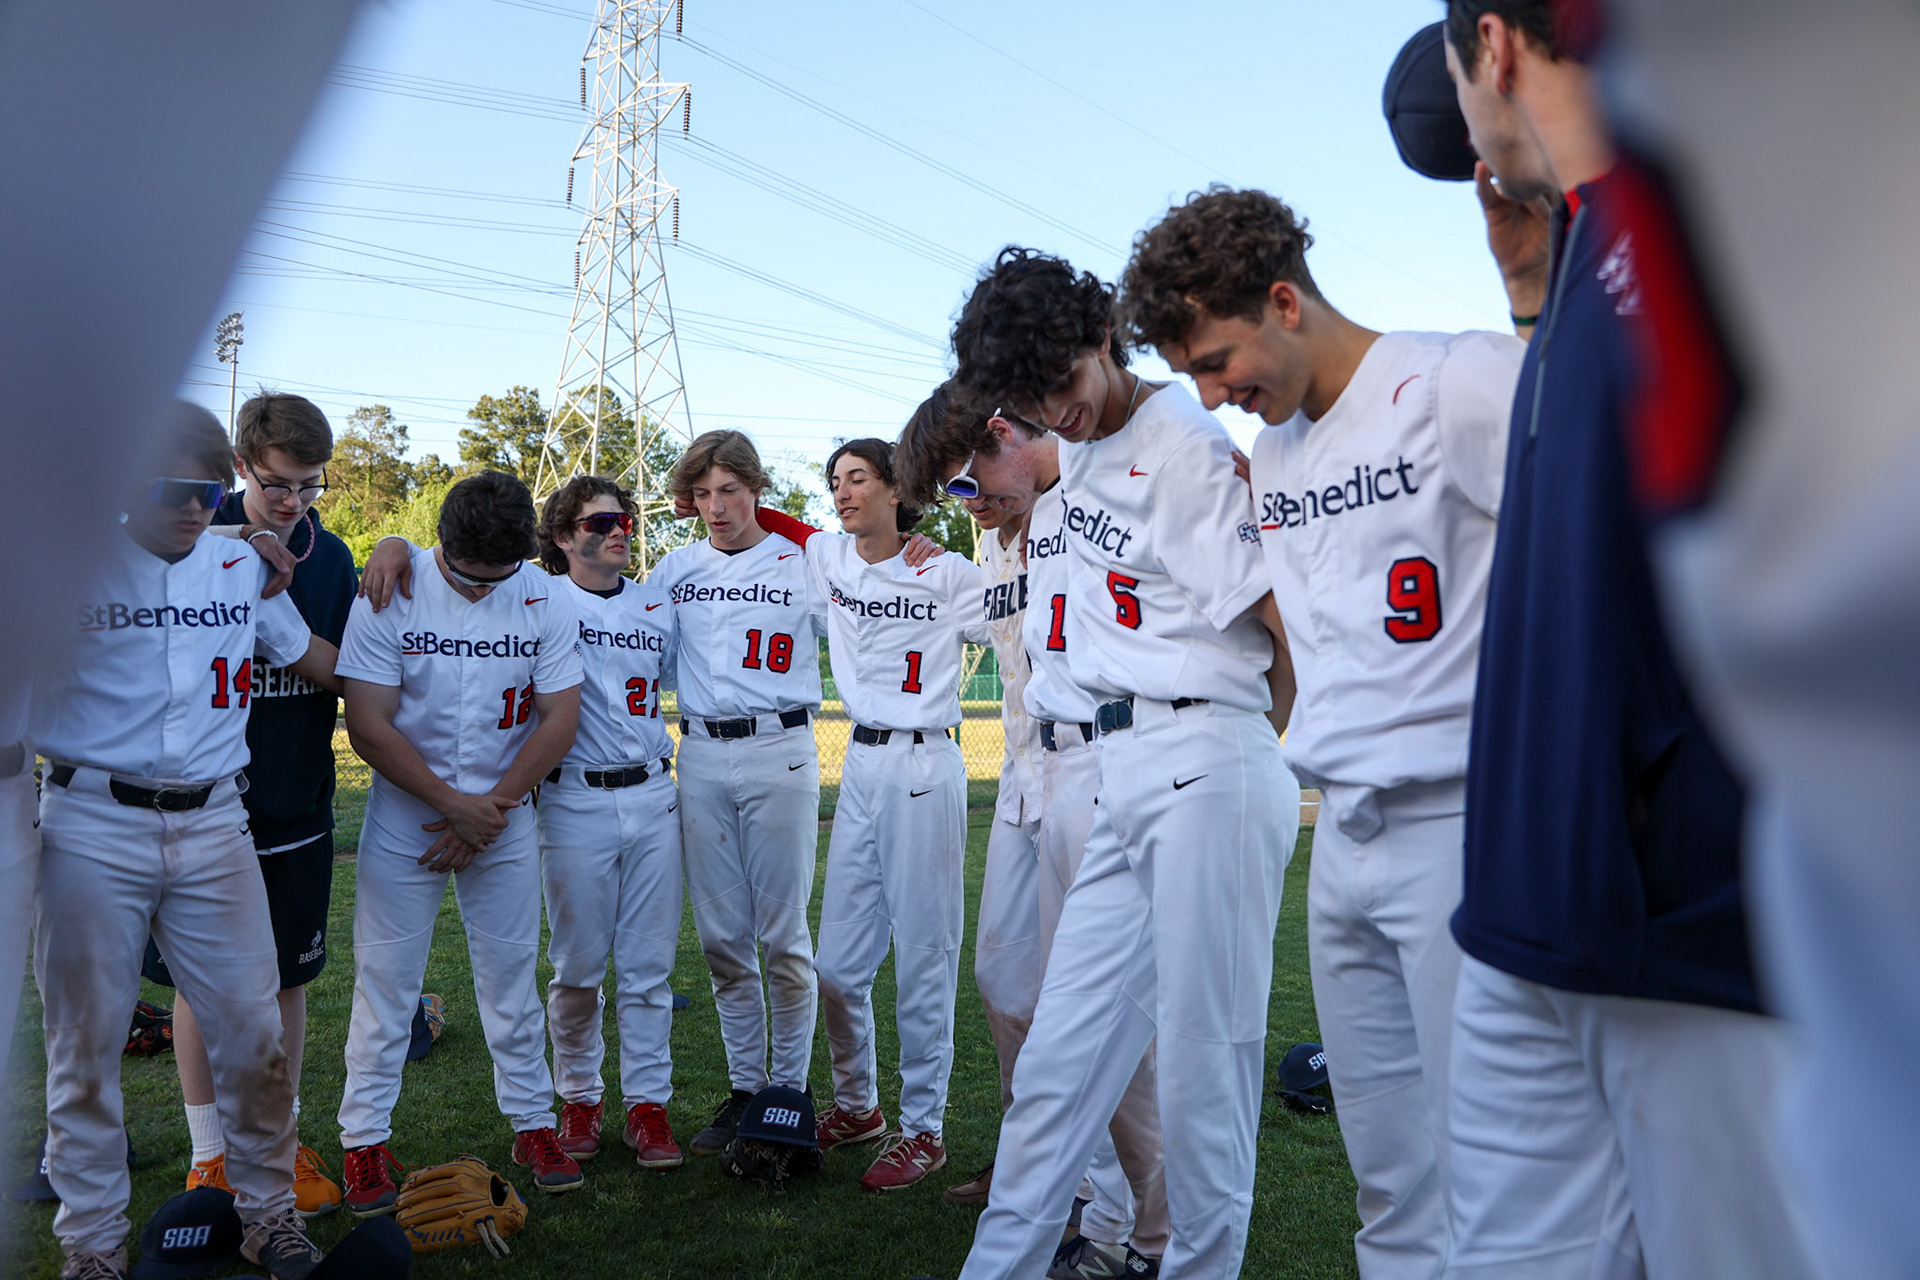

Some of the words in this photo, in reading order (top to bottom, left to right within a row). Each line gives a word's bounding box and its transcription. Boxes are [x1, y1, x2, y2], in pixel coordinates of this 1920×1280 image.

[1046, 593, 1067, 652] 1
[1107, 570, 1143, 631] 5
[1384, 556, 1443, 643] 9
[742, 628, 794, 674] 18
[901, 650, 923, 695] 1
[211, 657, 251, 709] 14
[497, 675, 533, 730] 12
[1308, 1050, 1327, 1071] SB
[761, 1106, 802, 1128] SBA
[162, 1215, 212, 1249] SBA
